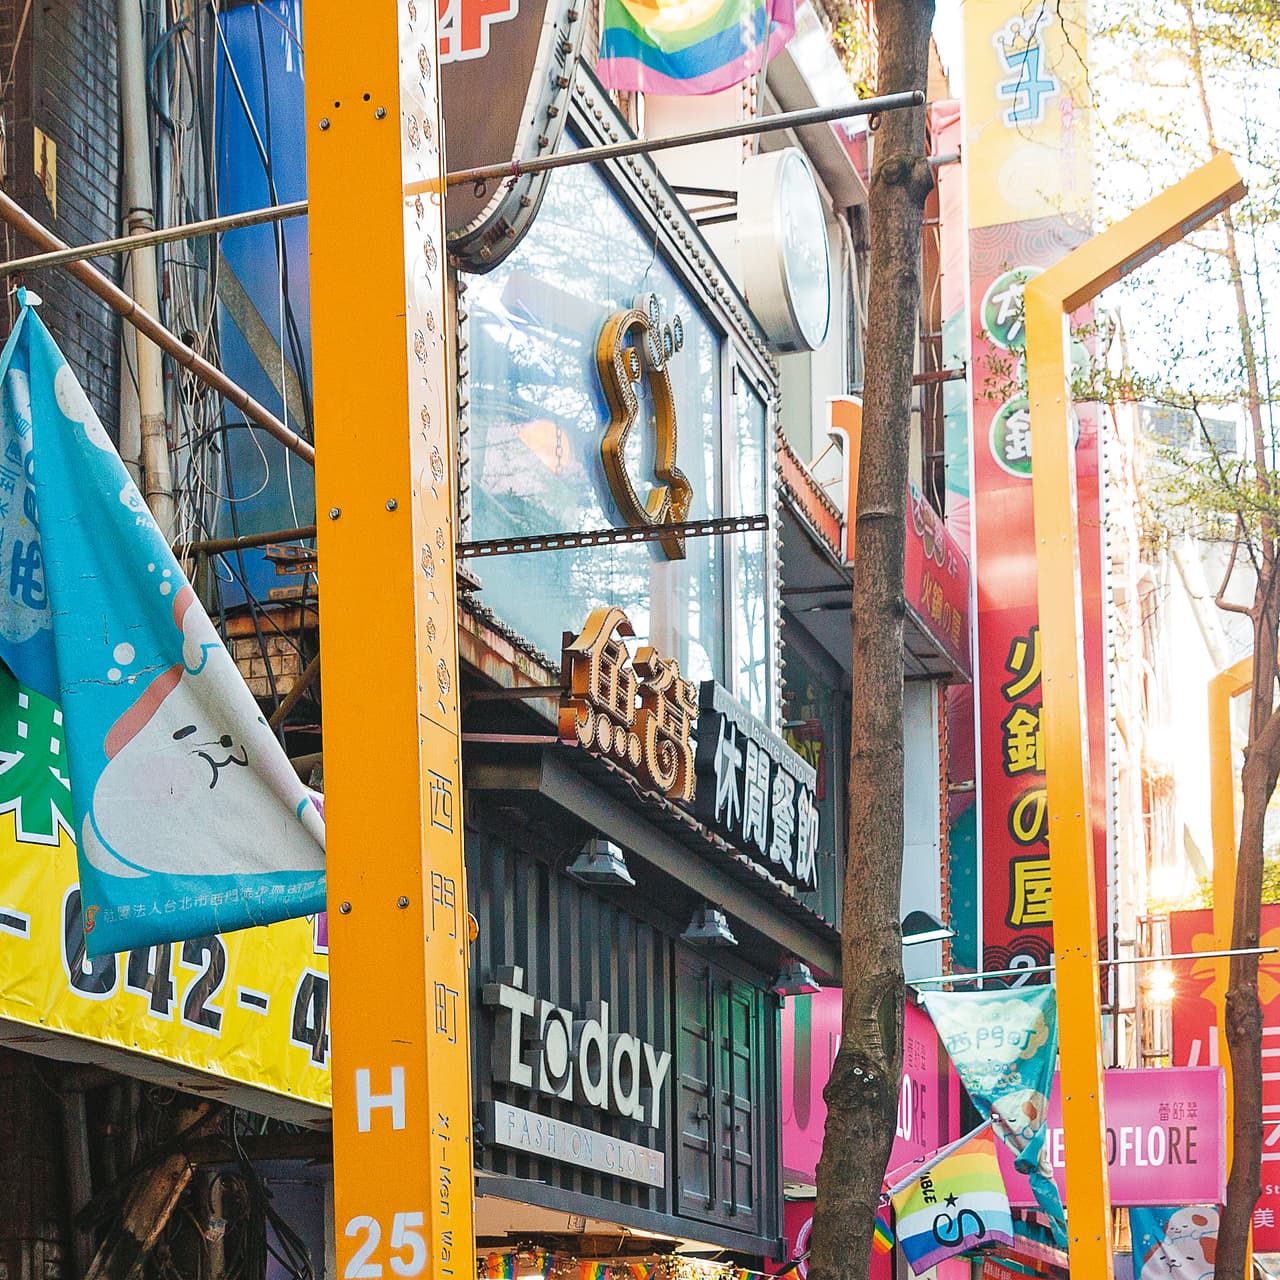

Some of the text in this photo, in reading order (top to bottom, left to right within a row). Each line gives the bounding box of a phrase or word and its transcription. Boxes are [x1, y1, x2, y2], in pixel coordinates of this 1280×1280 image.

[428, 769, 458, 1044] 西門町
[355, 1066, 406, 1132] H
[343, 1211, 428, 1280] 25
